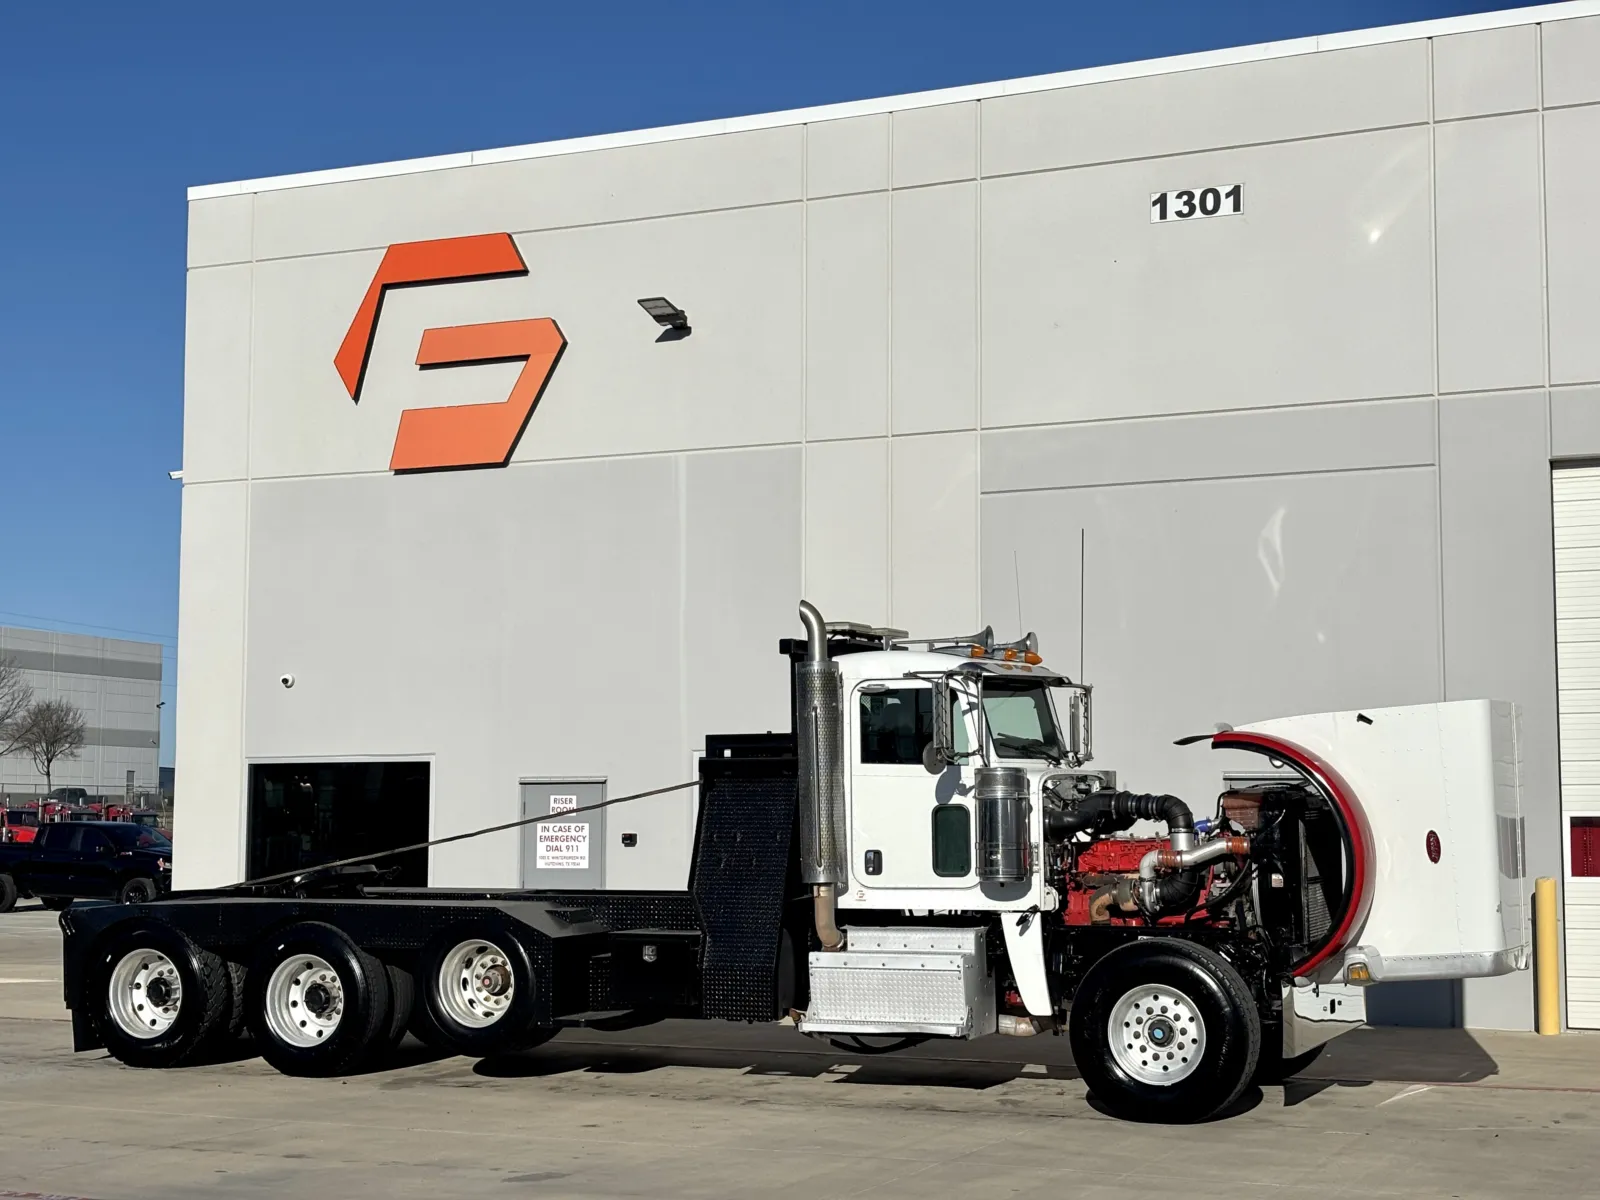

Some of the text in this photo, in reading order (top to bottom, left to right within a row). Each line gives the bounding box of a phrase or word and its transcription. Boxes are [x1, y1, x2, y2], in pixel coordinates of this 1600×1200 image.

[1152, 184, 1242, 220] 1301
[541, 825, 585, 833] IN CASE OF
[539, 835, 587, 843] EMERGENCY
[545, 845, 579, 853] DIAL 911
